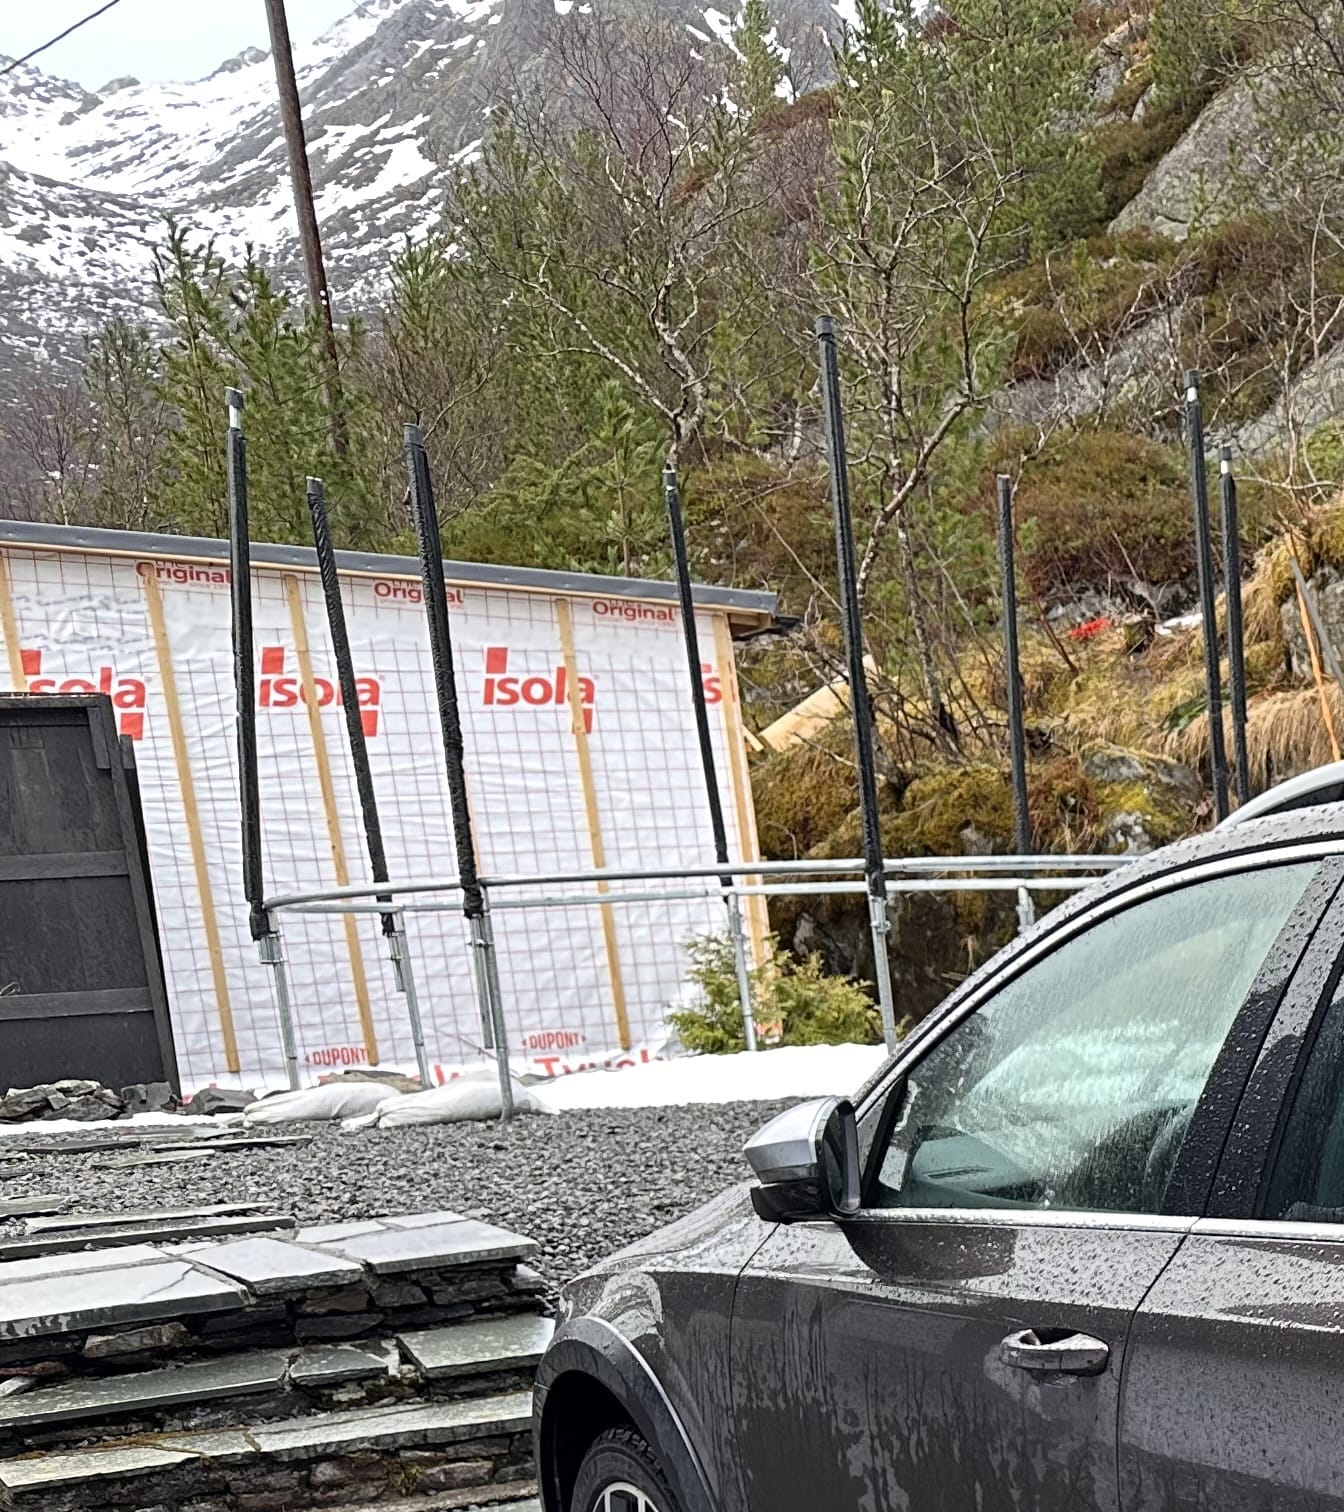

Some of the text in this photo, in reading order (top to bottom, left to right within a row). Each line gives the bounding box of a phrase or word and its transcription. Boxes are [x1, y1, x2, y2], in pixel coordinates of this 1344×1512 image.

[374, 582, 464, 604] Origal
[592, 601, 675, 622] Original
[484, 647, 595, 706] isola
[529, 1031, 579, 1050] DUPONT
[313, 1048, 366, 1066] DUPONT
